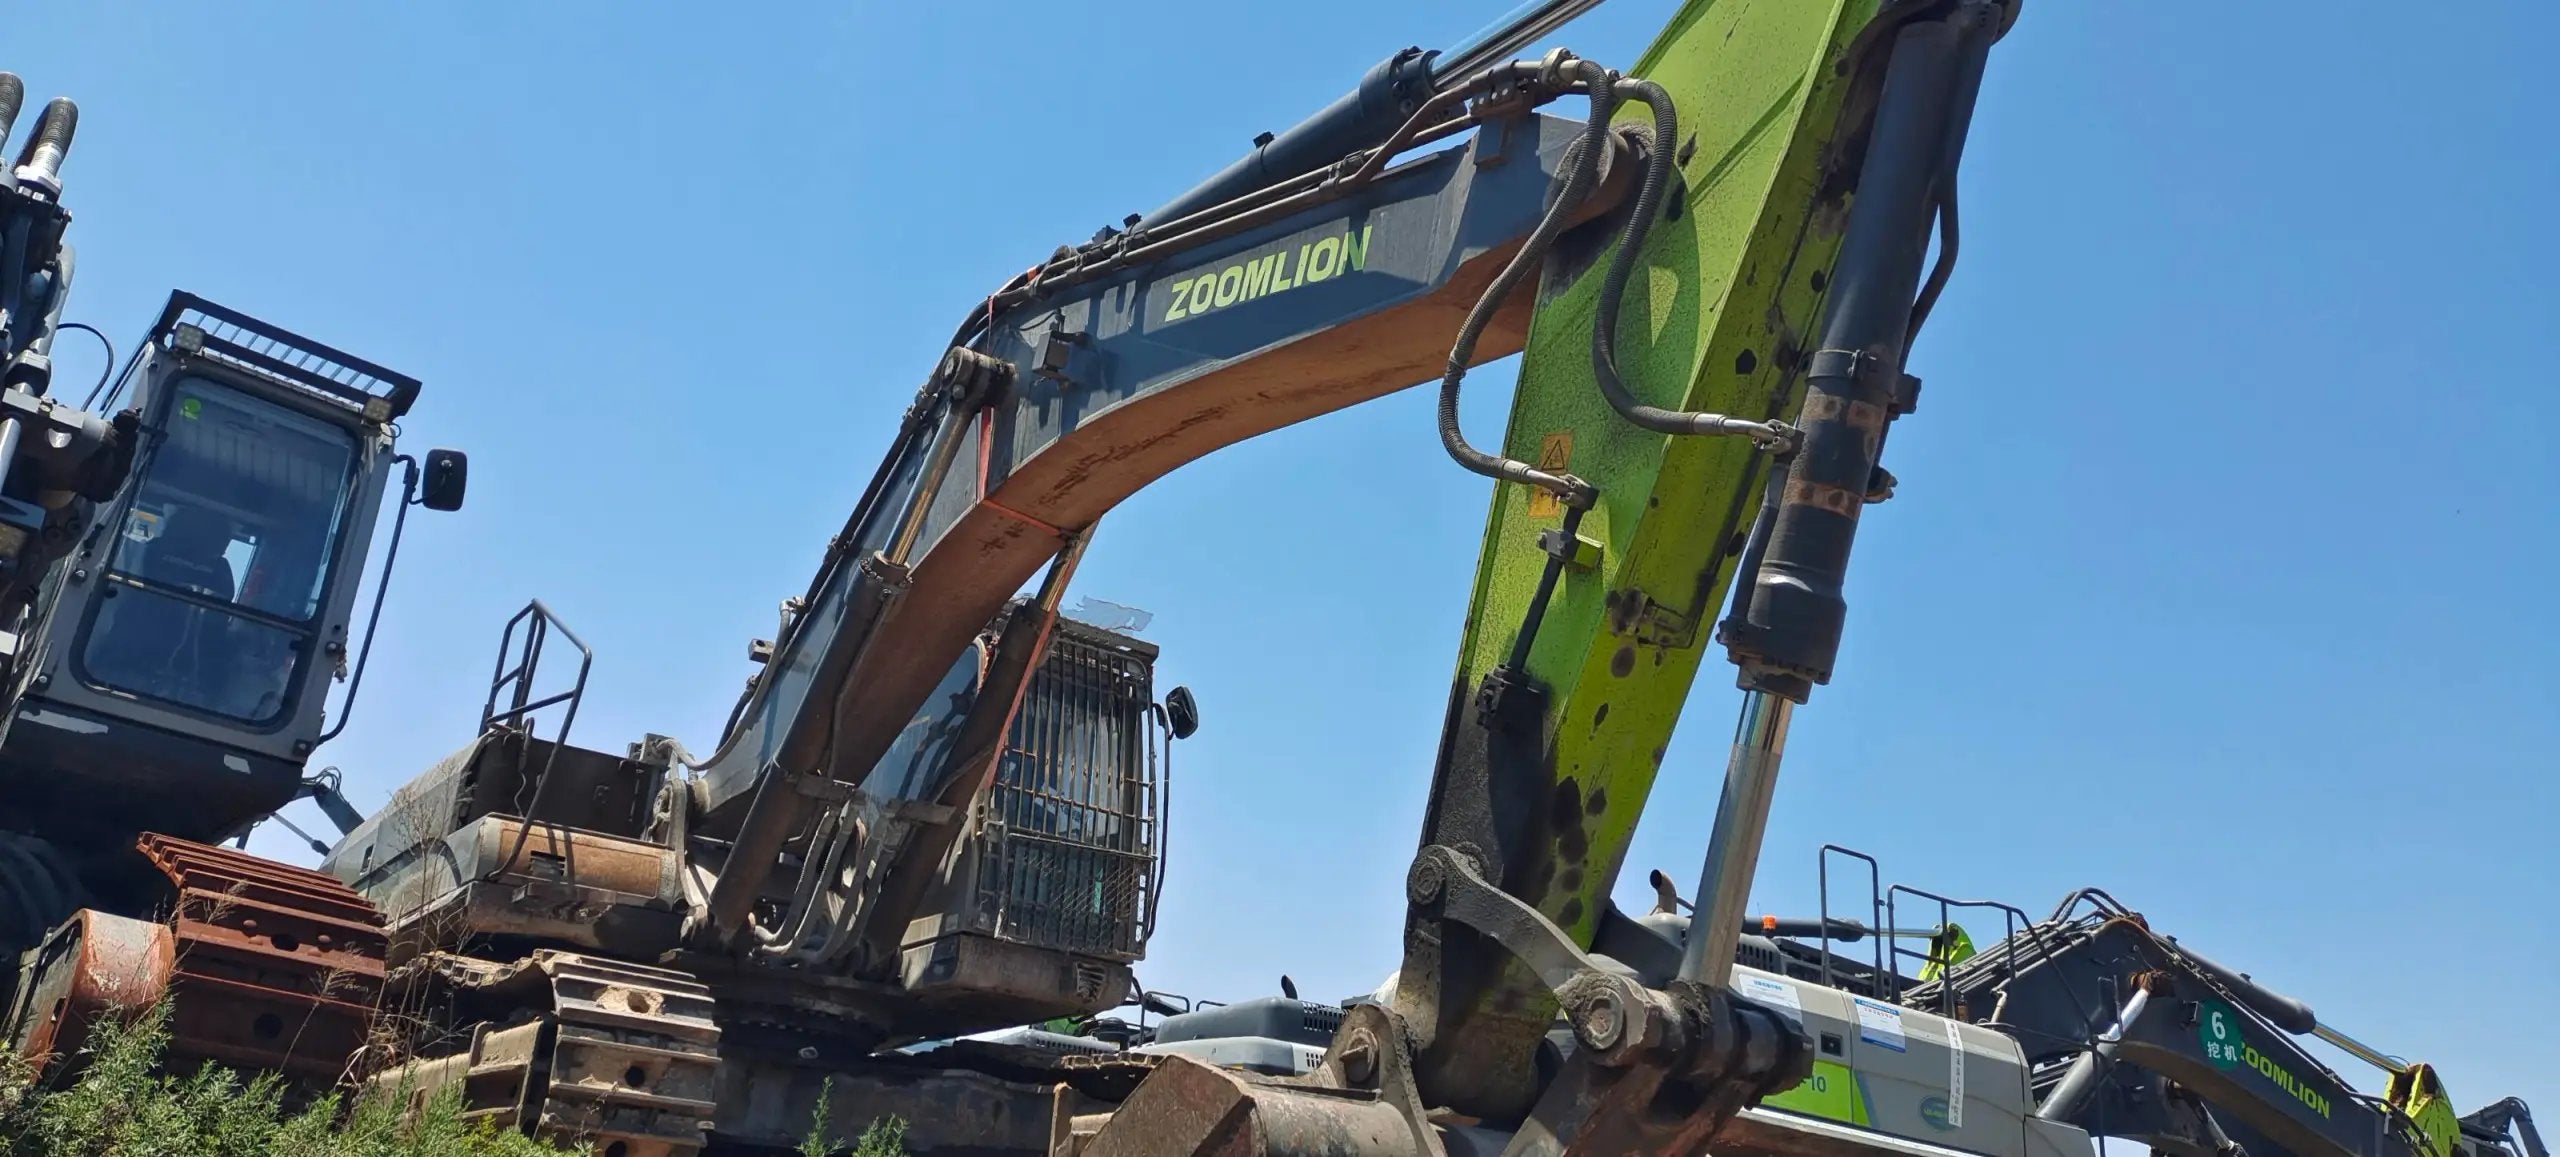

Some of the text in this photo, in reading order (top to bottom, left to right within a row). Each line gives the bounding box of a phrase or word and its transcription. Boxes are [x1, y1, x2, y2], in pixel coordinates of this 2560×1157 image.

[1164, 225, 1373, 322] ZOOMLION
[2211, 1011, 2226, 1040] 6
[2207, 1041, 2238, 1062] 挖机
